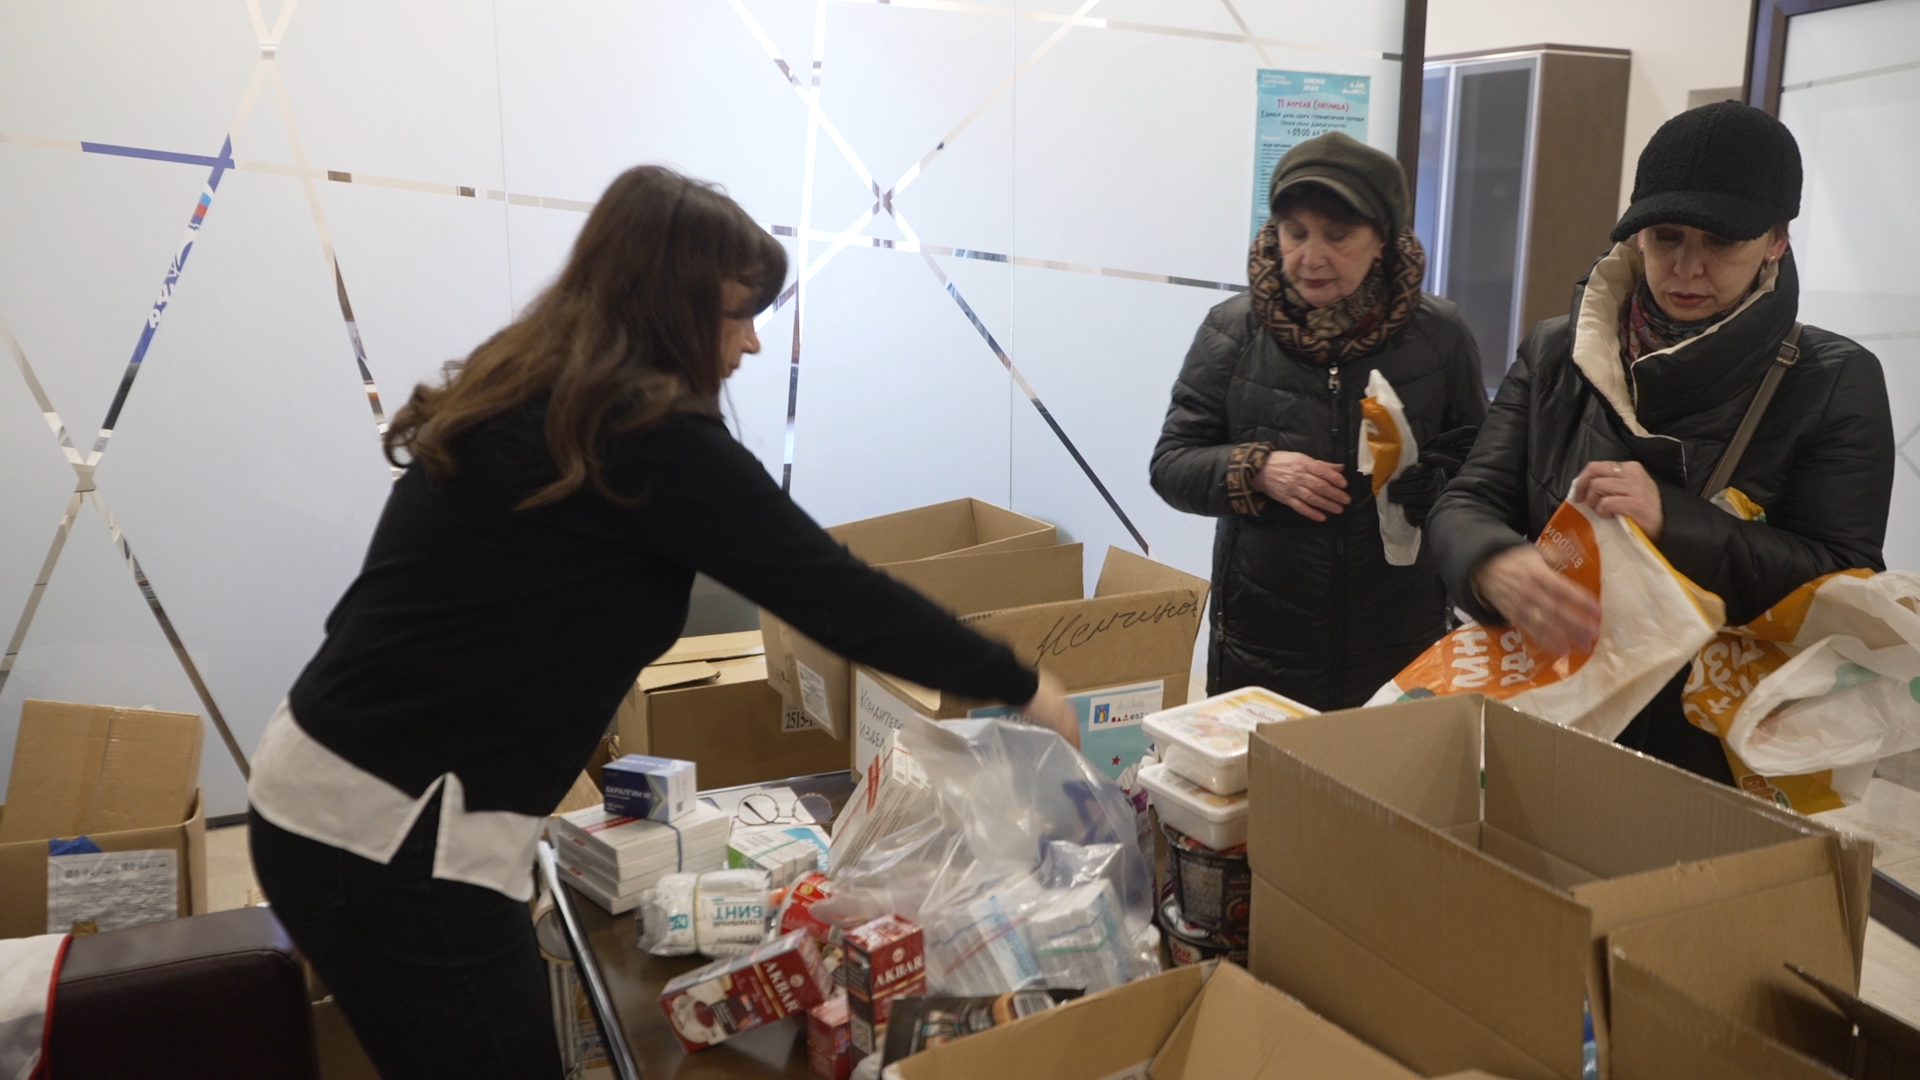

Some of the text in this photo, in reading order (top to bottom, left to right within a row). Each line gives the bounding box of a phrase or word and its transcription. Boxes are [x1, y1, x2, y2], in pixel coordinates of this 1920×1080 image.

[713, 905, 763, 920] БИНТ
[763, 961, 801, 1013] AKBAR
[874, 954, 925, 987] AKBAR
